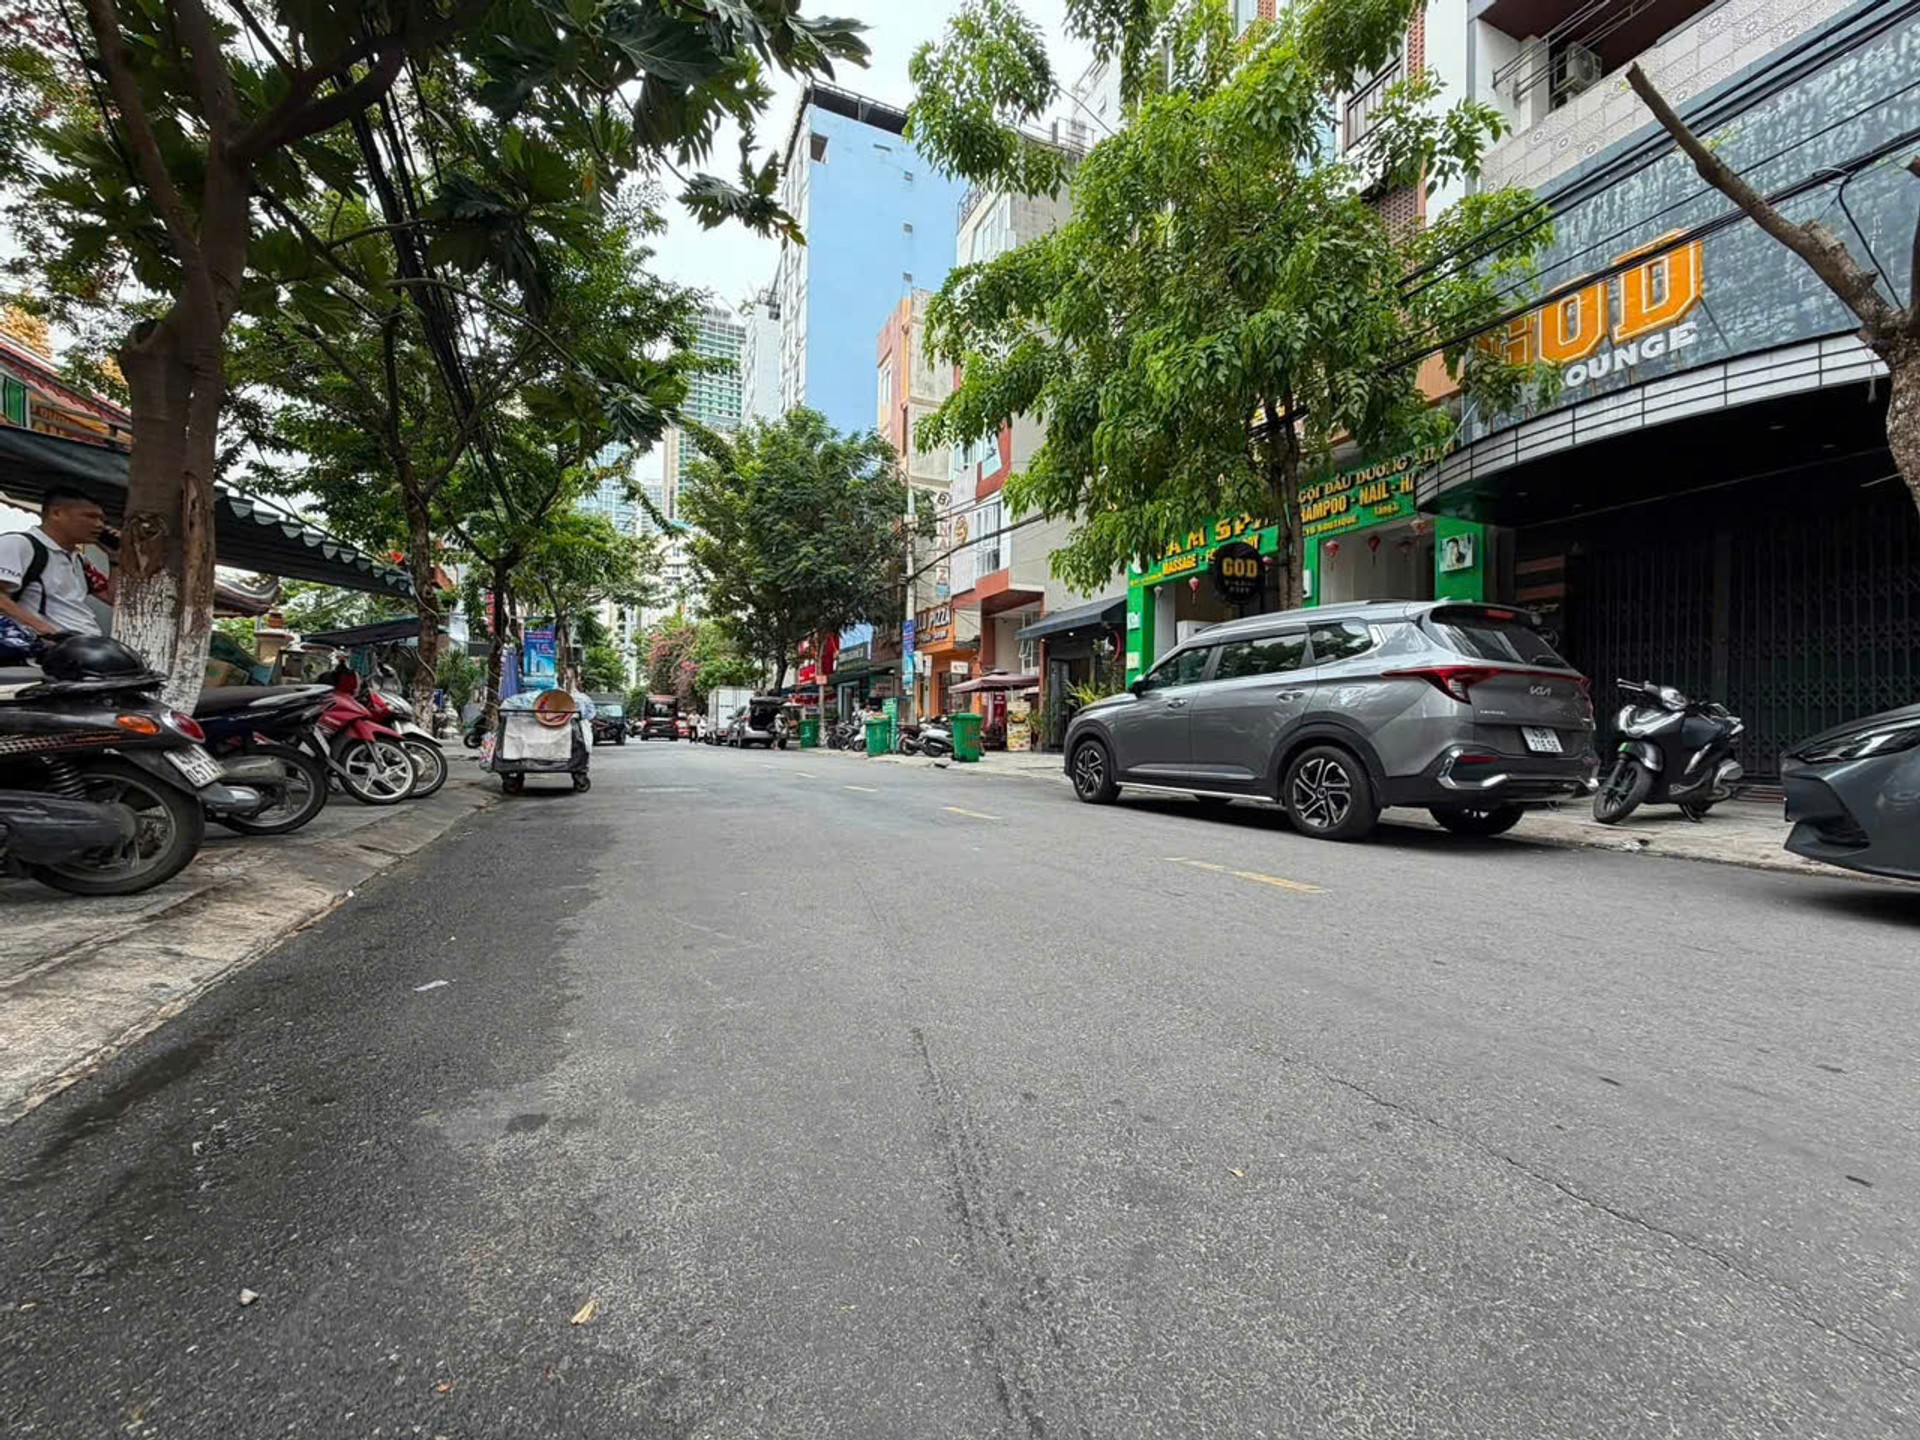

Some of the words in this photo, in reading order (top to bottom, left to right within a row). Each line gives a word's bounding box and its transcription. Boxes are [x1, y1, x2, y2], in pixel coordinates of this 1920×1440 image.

[1562, 322, 1698, 387] OUNGE
[1359, 480, 1390, 506] NAIL
[1162, 552, 1198, 575] MASSAGE
[1222, 556, 1258, 578] GOD
